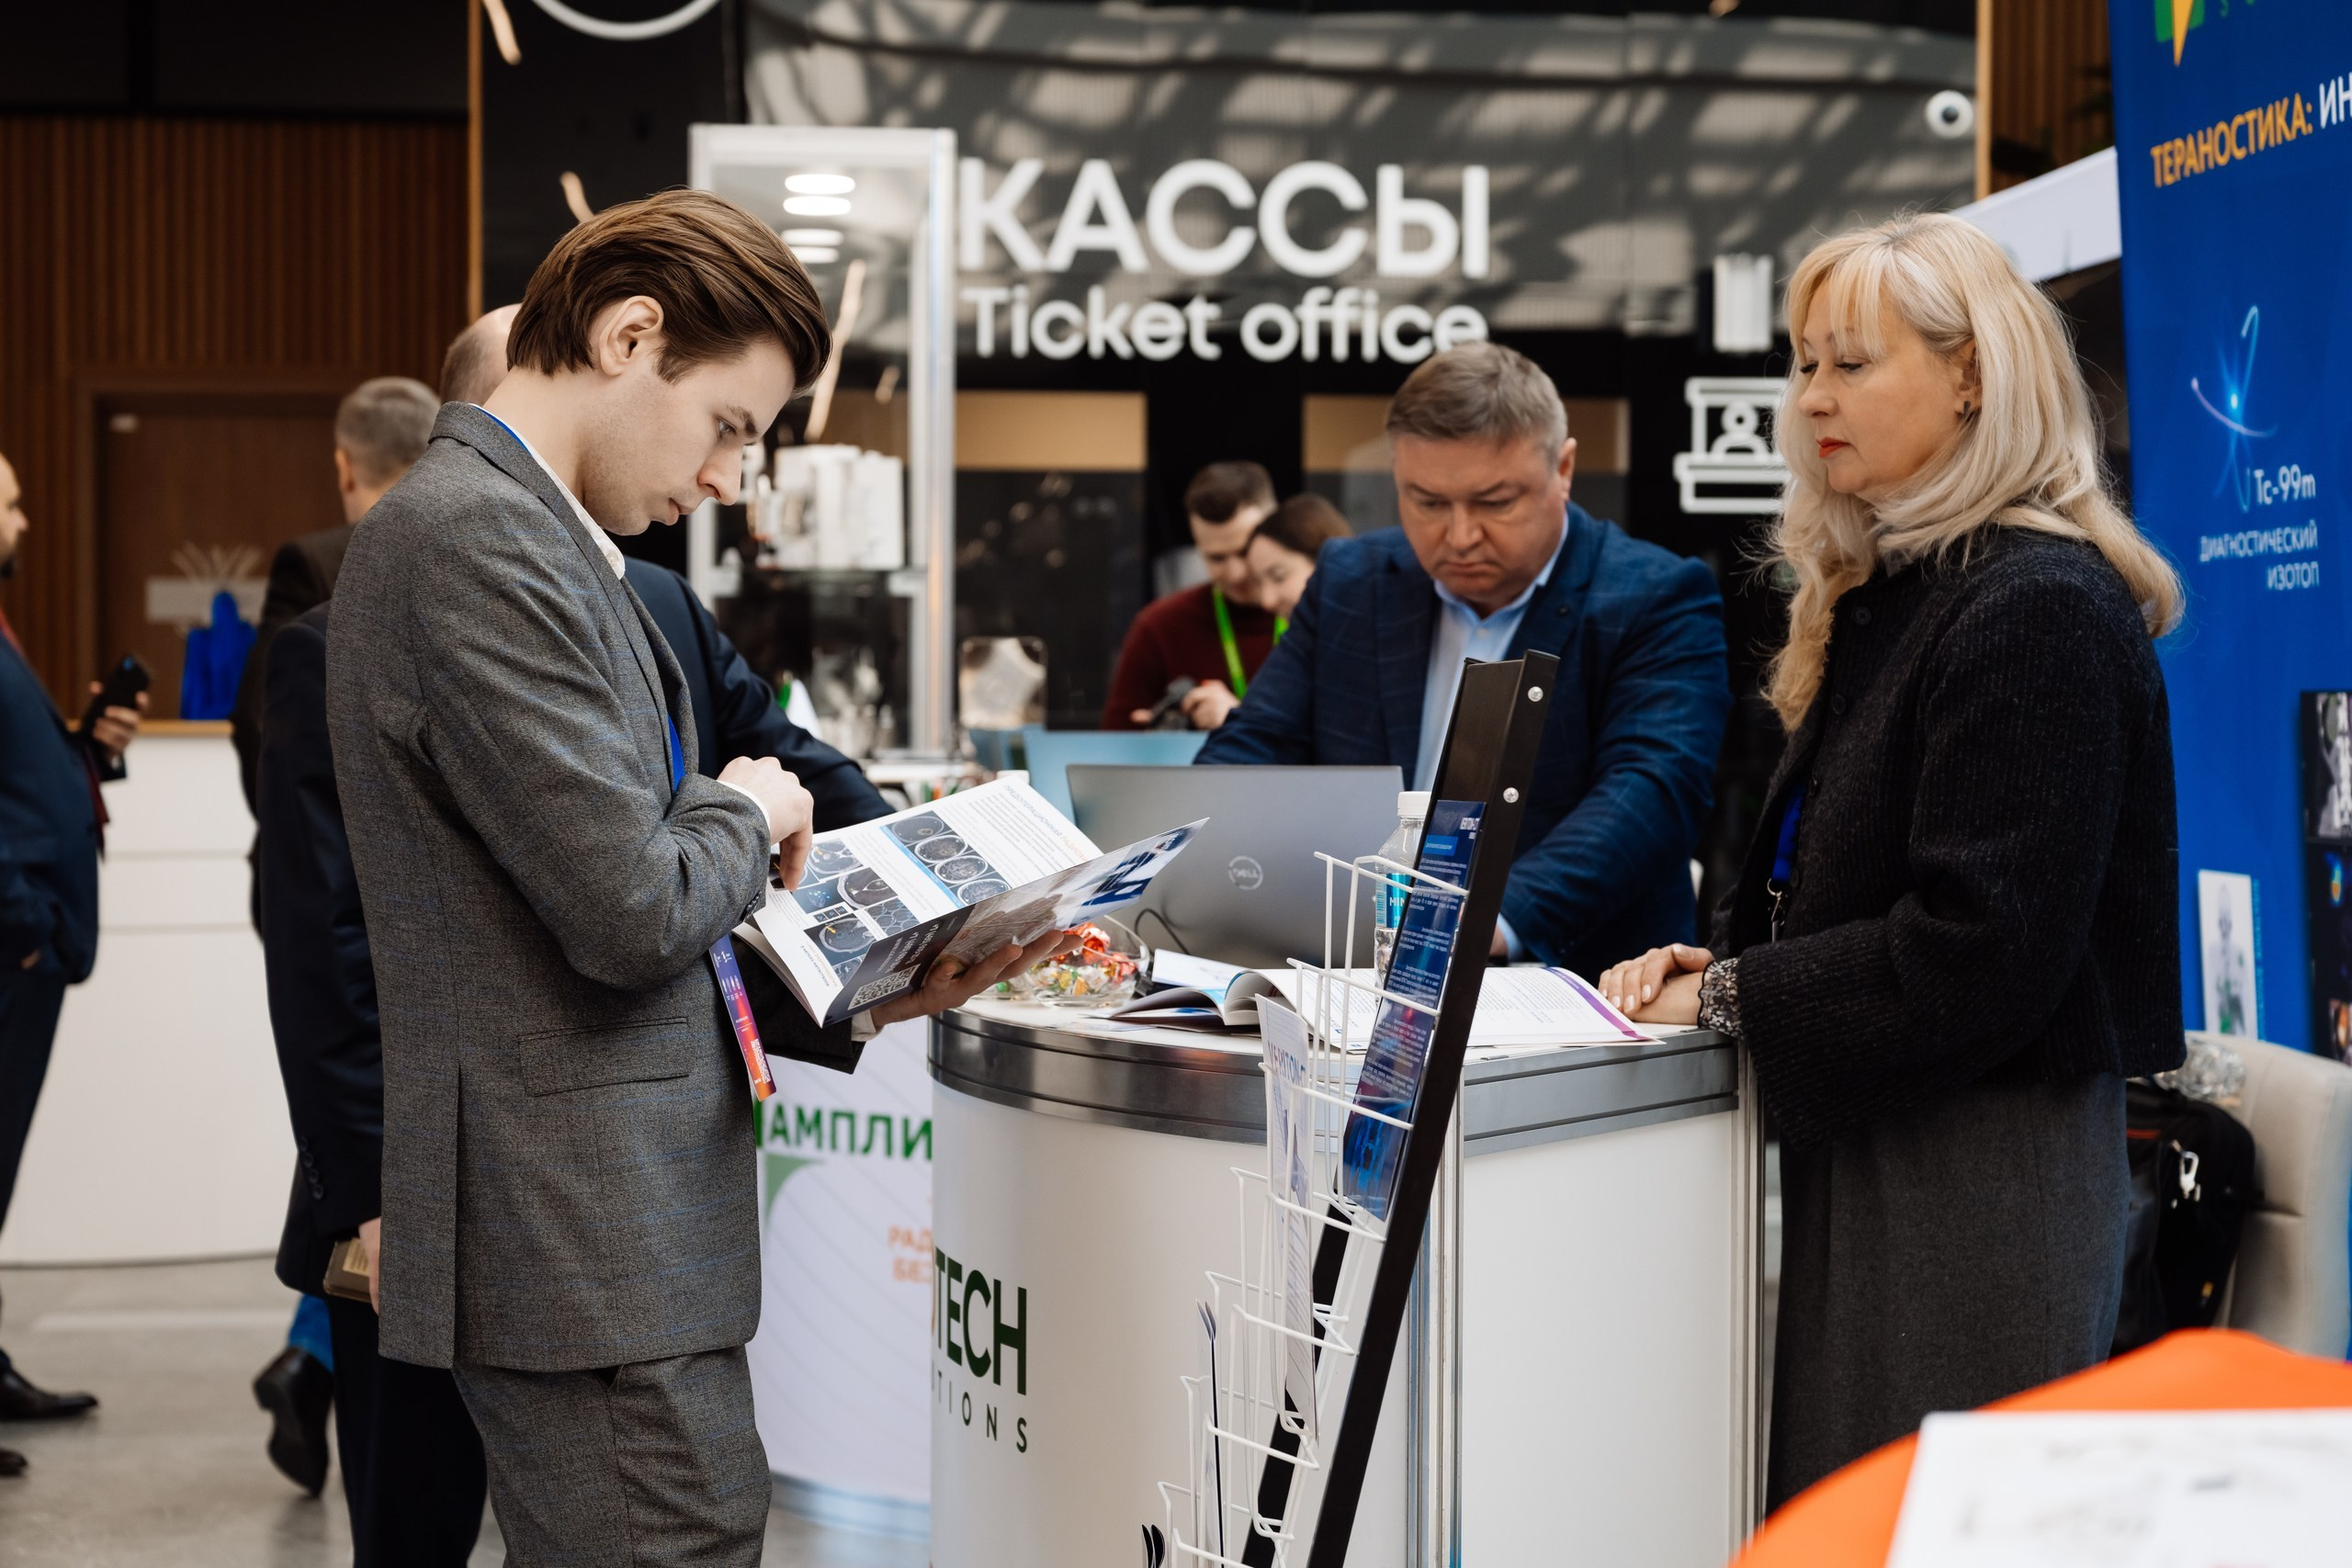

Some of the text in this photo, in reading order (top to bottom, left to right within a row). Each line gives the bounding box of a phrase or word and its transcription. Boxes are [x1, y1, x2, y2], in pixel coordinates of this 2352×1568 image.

[2150, 93, 2313, 188] ТЕРАНОСТИКА:
[958, 158, 1489, 277] КАССЫ
[958, 285, 1488, 364] Ticket office
[2253, 463, 2316, 505] Tc-99m
[2199, 519, 2318, 563] ДИАГНОСТИЧЕСКИЙ
[2267, 560, 2320, 591] ИЗОТОП
[931, 1245, 1027, 1397] TECH
[931, 1358, 1028, 1454] TIONS
